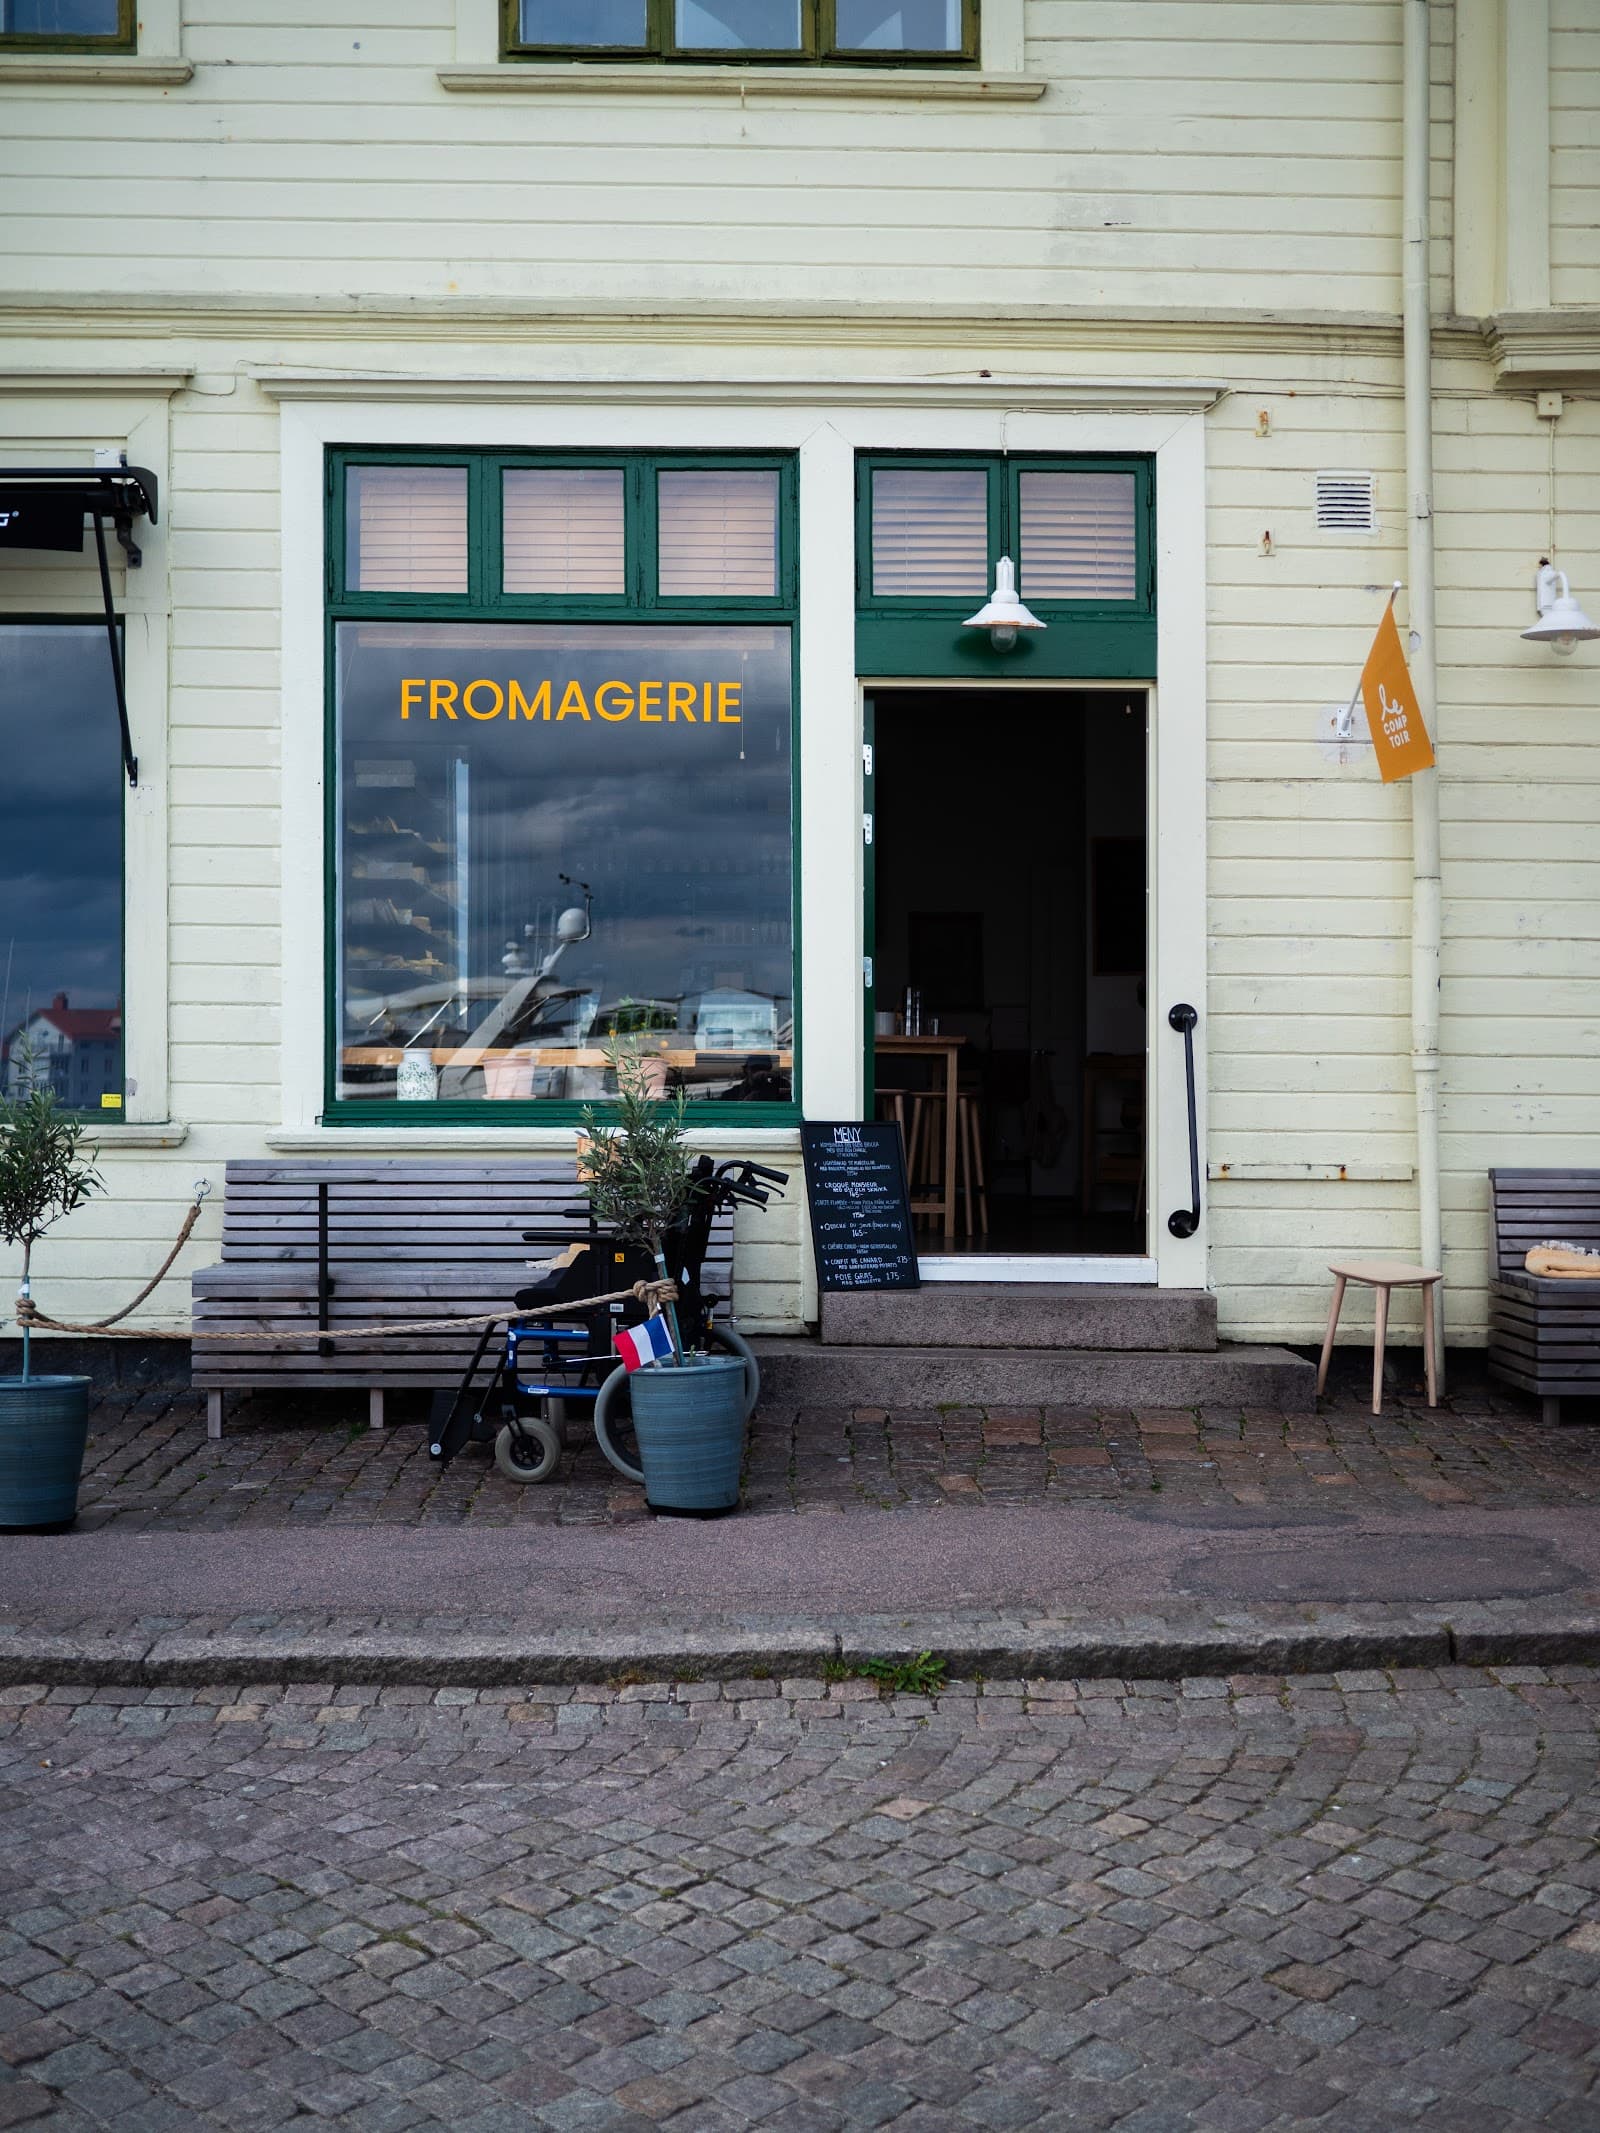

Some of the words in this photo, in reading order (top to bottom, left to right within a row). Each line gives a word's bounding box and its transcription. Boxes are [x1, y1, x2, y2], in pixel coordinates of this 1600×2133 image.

[400, 679, 742, 723] FROMAGERIE
[1383, 716, 1408, 735] COMP
[1389, 730, 1410, 749] TOIR
[833, 1126, 861, 1142] MENY
[824, 1181, 849, 1189] CROQUE
[834, 1273, 852, 1281] FOIE
[854, 1272, 873, 1280] GRAS
